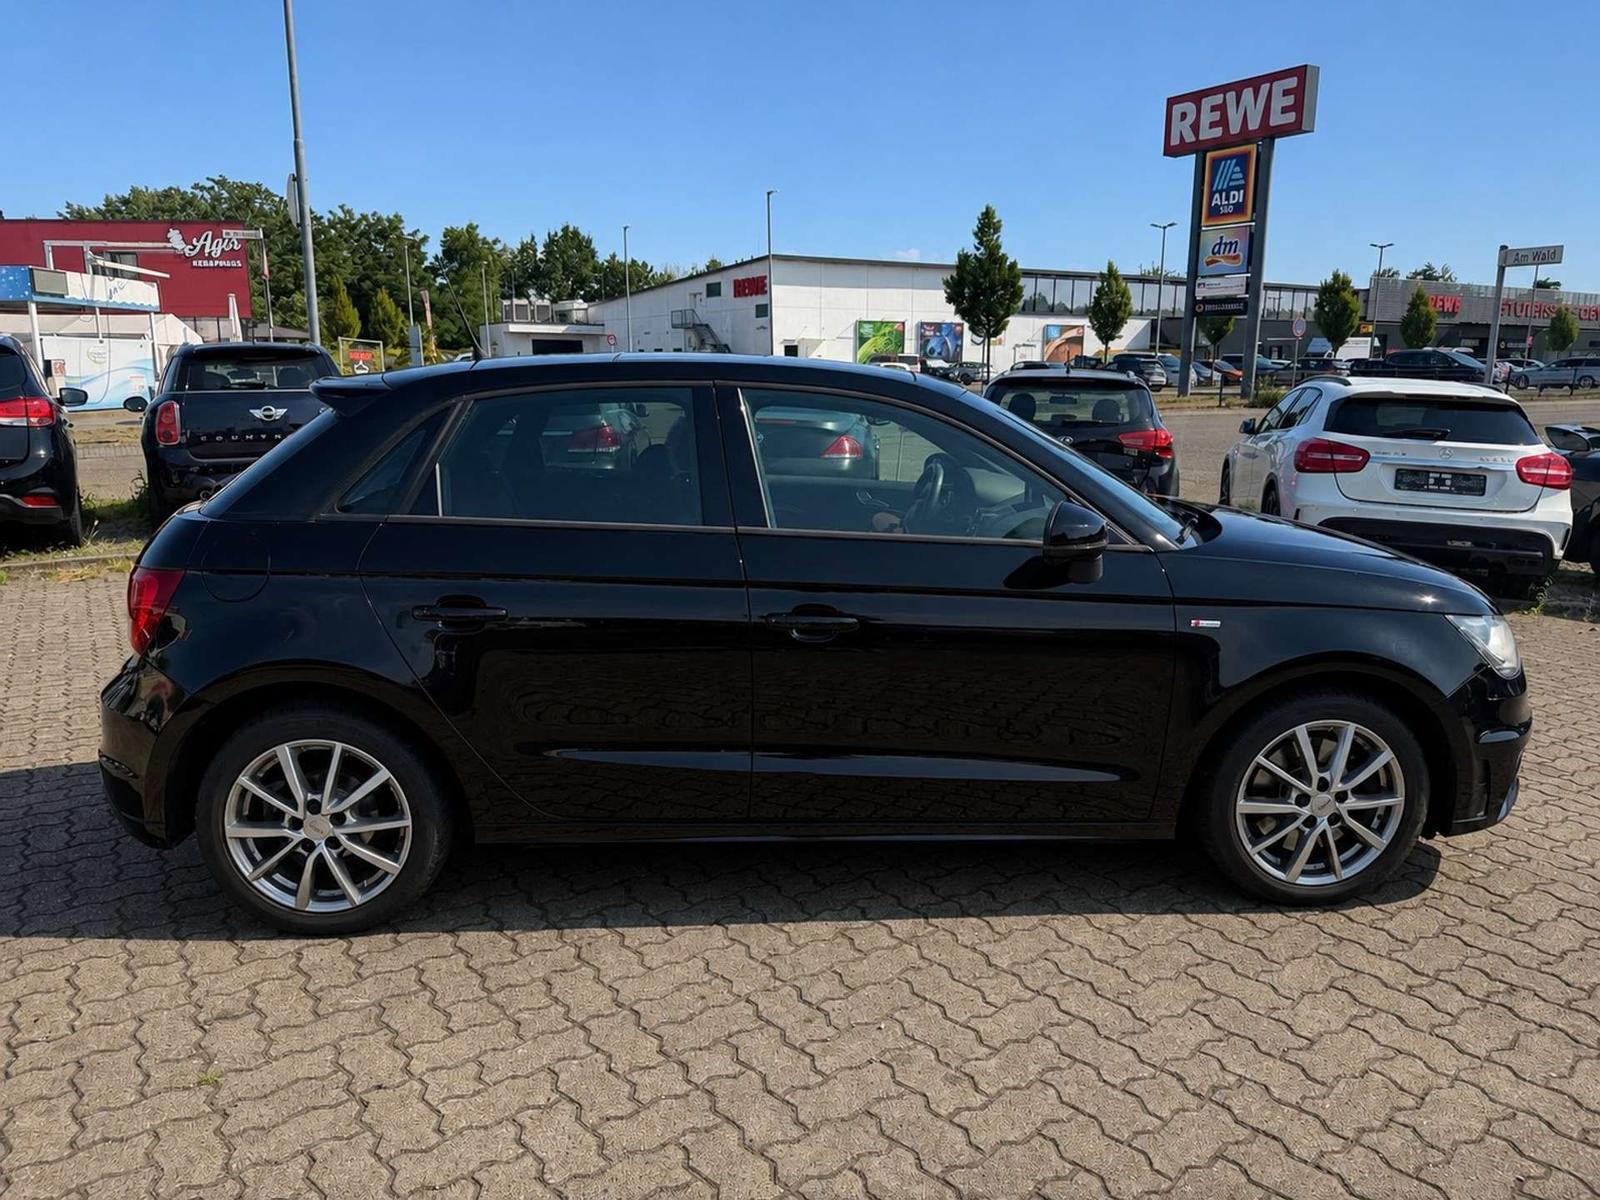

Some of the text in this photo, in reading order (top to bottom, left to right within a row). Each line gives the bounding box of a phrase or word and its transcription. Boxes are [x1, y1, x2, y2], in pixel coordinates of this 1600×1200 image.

[1170, 76, 1298, 146] REWE
[1211, 189, 1244, 207] ALDI
[1211, 235, 1239, 256] dm
[1513, 249, 1557, 263] Am Wald
